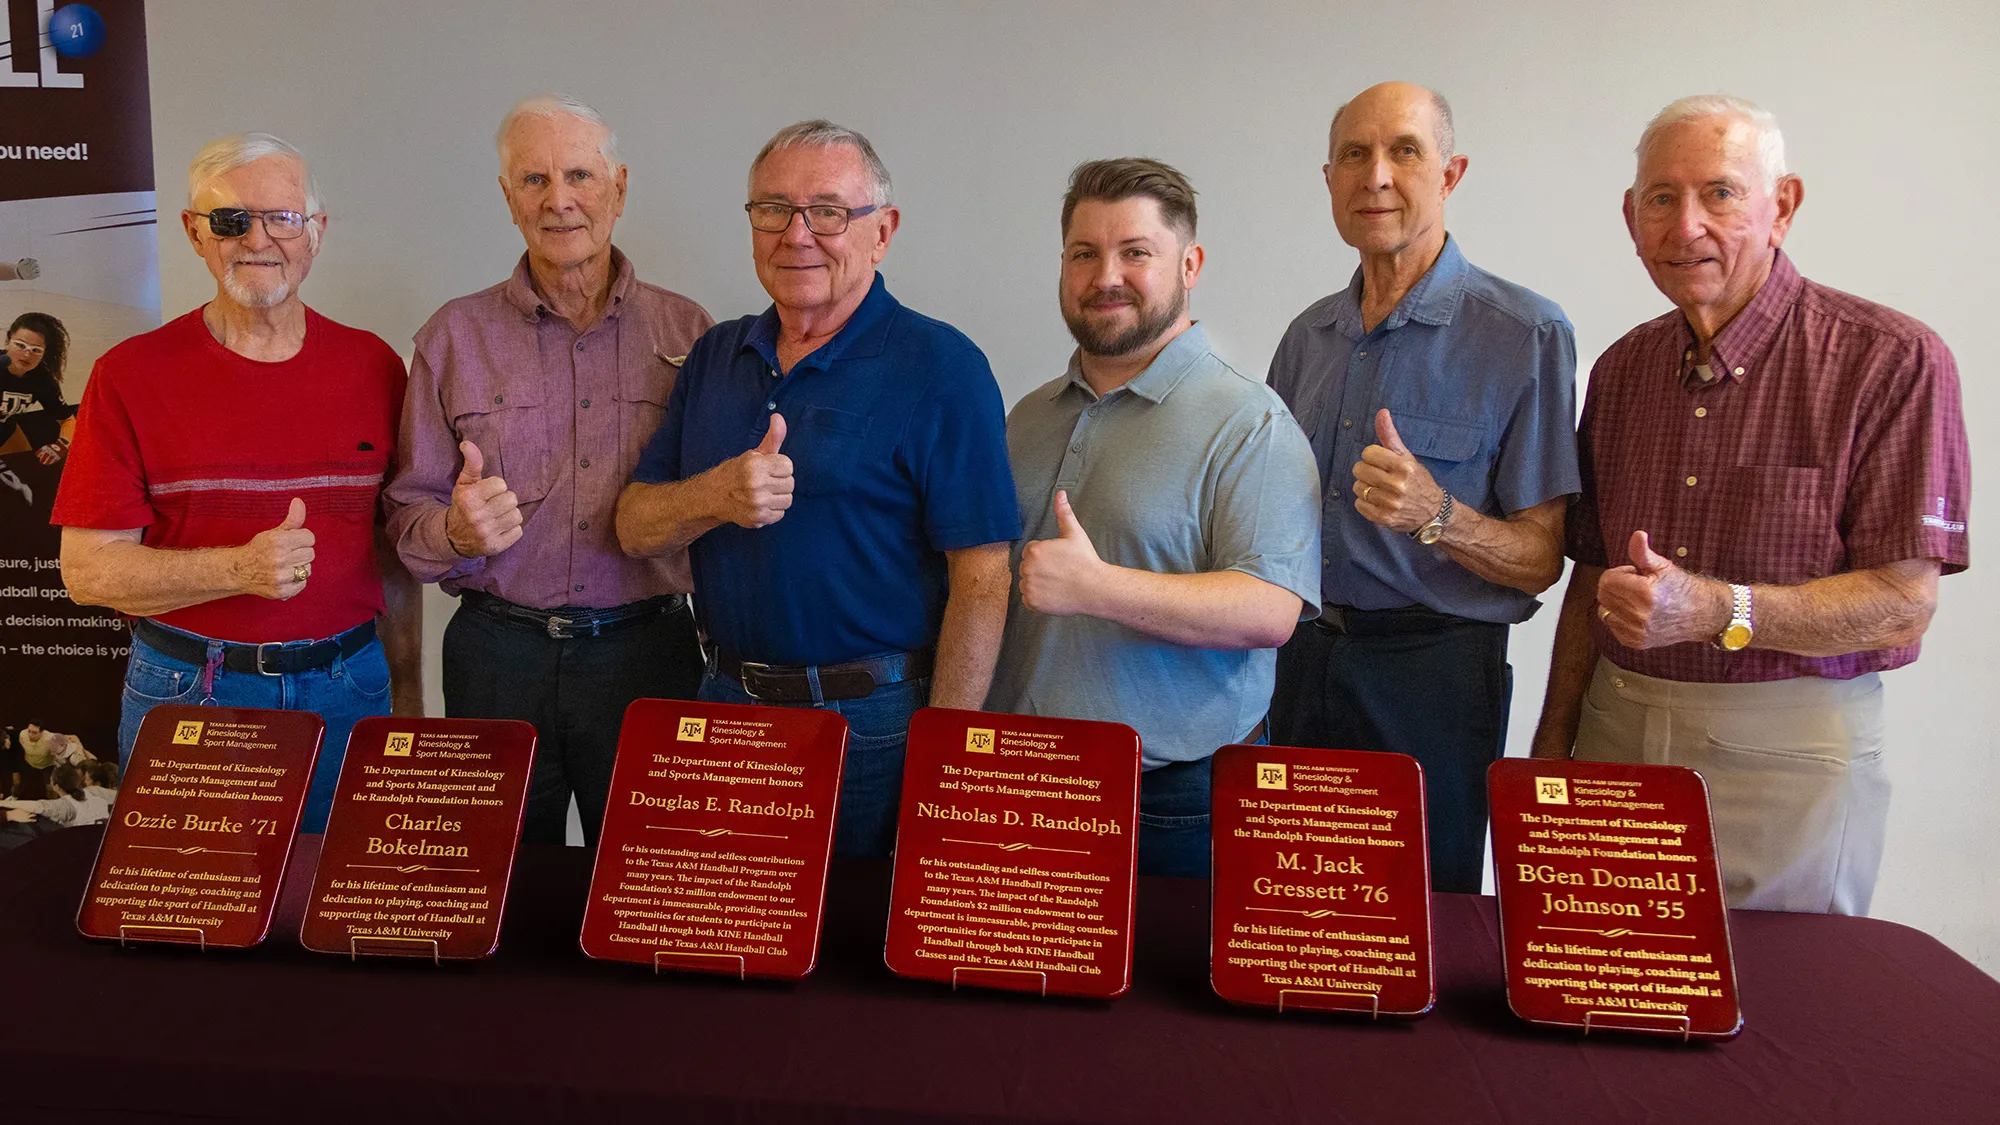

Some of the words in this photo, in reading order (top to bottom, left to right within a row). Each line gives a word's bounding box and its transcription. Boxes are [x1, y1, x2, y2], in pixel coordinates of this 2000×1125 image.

[71, 23, 84, 38] 21
[26, 143, 88, 160] need!
[34, 557, 60, 572] just
[40, 588, 69, 601] apa
[6, 614, 64, 626] decision
[67, 616, 125, 631] making.
[22, 644, 44, 655] the
[48, 644, 94, 656] choice
[96, 644, 108, 656] is
[206, 729, 251, 739] Kinesiology
[711, 726, 757, 737] Kinesiology
[203, 739, 225, 747] Sport
[226, 740, 277, 750] Management
[418, 740, 463, 750] Kinesiology
[709, 736, 732, 745] Sport
[733, 738, 786, 748] Management
[416, 750, 438, 758] Sport
[439, 751, 491, 760] Management
[150, 759, 166, 768] The
[167, 760, 221, 771] Department
[222, 763, 234, 771] of
[234, 764, 287, 776] Kinesiology
[150, 773, 169, 781] and
[169, 774, 199, 784] Sports
[199, 776, 258, 787] Management
[259, 780, 277, 788] and
[942, 765, 961, 775] The
[963, 767, 1025, 780] Department
[1027, 772, 1039, 782] of
[1040, 774, 1101, 789] Kinesiology
[136, 786, 151, 794] the
[152, 787, 196, 799] Randolph
[198, 789, 250, 800] Foundation
[251, 792, 283, 802] honors
[939, 781, 959, 790] and
[961, 782, 994, 793] Sports
[996, 785, 1062, 799] Management
[1064, 790, 1101, 802] honors
[1574, 786, 1626, 798] Kinesiology
[1628, 789, 1636, 797] &
[629, 791, 700, 811] Douglas
[705, 797, 721, 812] E.
[728, 798, 815, 820] Randolph
[1575, 798, 1601, 807] Sport
[1602, 799, 1665, 810] Management
[124, 811, 177, 829] Ozzie
[182, 814, 243, 833] Burke
[385, 813, 461, 832] Charles
[917, 802, 997, 824] Nicholas
[1003, 810, 1024, 826] D.
[1031, 813, 1122, 836] Randolph
[1519, 813, 1541, 823] The
[1542, 814, 1608, 827] Department
[1608, 818, 1622, 828] of
[1622, 819, 1688, 833] Kinesiology
[1529, 830, 1550, 838] and
[1551, 830, 1587, 842] Sports
[1588, 832, 1659, 845] Management
[1660, 837, 1682, 846] and
[366, 837, 468, 857] Bokelman
[622, 844, 635, 852] for
[635, 845, 648, 853] his
[649, 848, 699, 859] outstanding
[718, 852, 747, 861] selfless
[748, 856, 805, 865] contributions
[1518, 843, 1536, 853] the
[1538, 844, 1591, 858] Randolph
[1593, 848, 1656, 860] Foundation
[1657, 851, 1697, 862] honors
[1276, 852, 1307, 870] M.
[1313, 854, 1365, 875] Jack
[330, 879, 346, 888] for
[346, 880, 361, 889] his
[362, 881, 400, 891] lifetime
[400, 882, 413, 891] of
[412, 883, 466, 893] enthusiasm
[468, 886, 487, 894] and
[1516, 864, 1586, 885] BGen
[1590, 868, 1681, 891] Donald
[1686, 874, 1706, 895] J.
[674, 886, 684, 895] $2
[685, 888, 716, 897] million
[718, 891, 768, 901] endowment
[1253, 877, 1346, 900] Gressett
[322, 894, 372, 904] dedication
[385, 897, 424, 909] playing,
[426, 899, 469, 910] coaching
[470, 900, 489, 909] and
[1542, 892, 1642, 917] Johnson
[121, 911, 146, 921] Texas
[147, 913, 174, 923] A&M
[175, 914, 224, 928] University
[904, 908, 955, 920] department
[957, 913, 964, 921] is
[966, 914, 1030, 928] immeasurable,
[1032, 922, 1075, 933] providing
[1076, 926, 1118, 935] countless
[346, 925, 372, 934] Texas
[374, 926, 401, 936] A&M
[403, 928, 452, 940] University
[1233, 923, 1250, 933] for
[1251, 924, 1268, 934] his
[1269, 925, 1311, 937] lifetime
[1312, 929, 1325, 938] of
[1325, 930, 1387, 943] enthusiasm
[1388, 935, 1410, 944] and
[1228, 938, 1284, 952] dedication
[1286, 944, 1298, 952] to
[1299, 944, 1343, 958] playing,
[1344, 948, 1394, 962] coaching
[1394, 951, 1416, 961] and
[1228, 957, 1287, 971] supporting
[1289, 959, 1307, 969] the
[1308, 963, 1337, 973] sport
[1338, 963, 1352, 973] of
[1353, 964, 1404, 976] Handball
[1405, 969, 1416, 978] at
[1262, 973, 1292, 984] Texas
[1294, 976, 1324, 987] A&M
[1326, 978, 1382, 993] University
